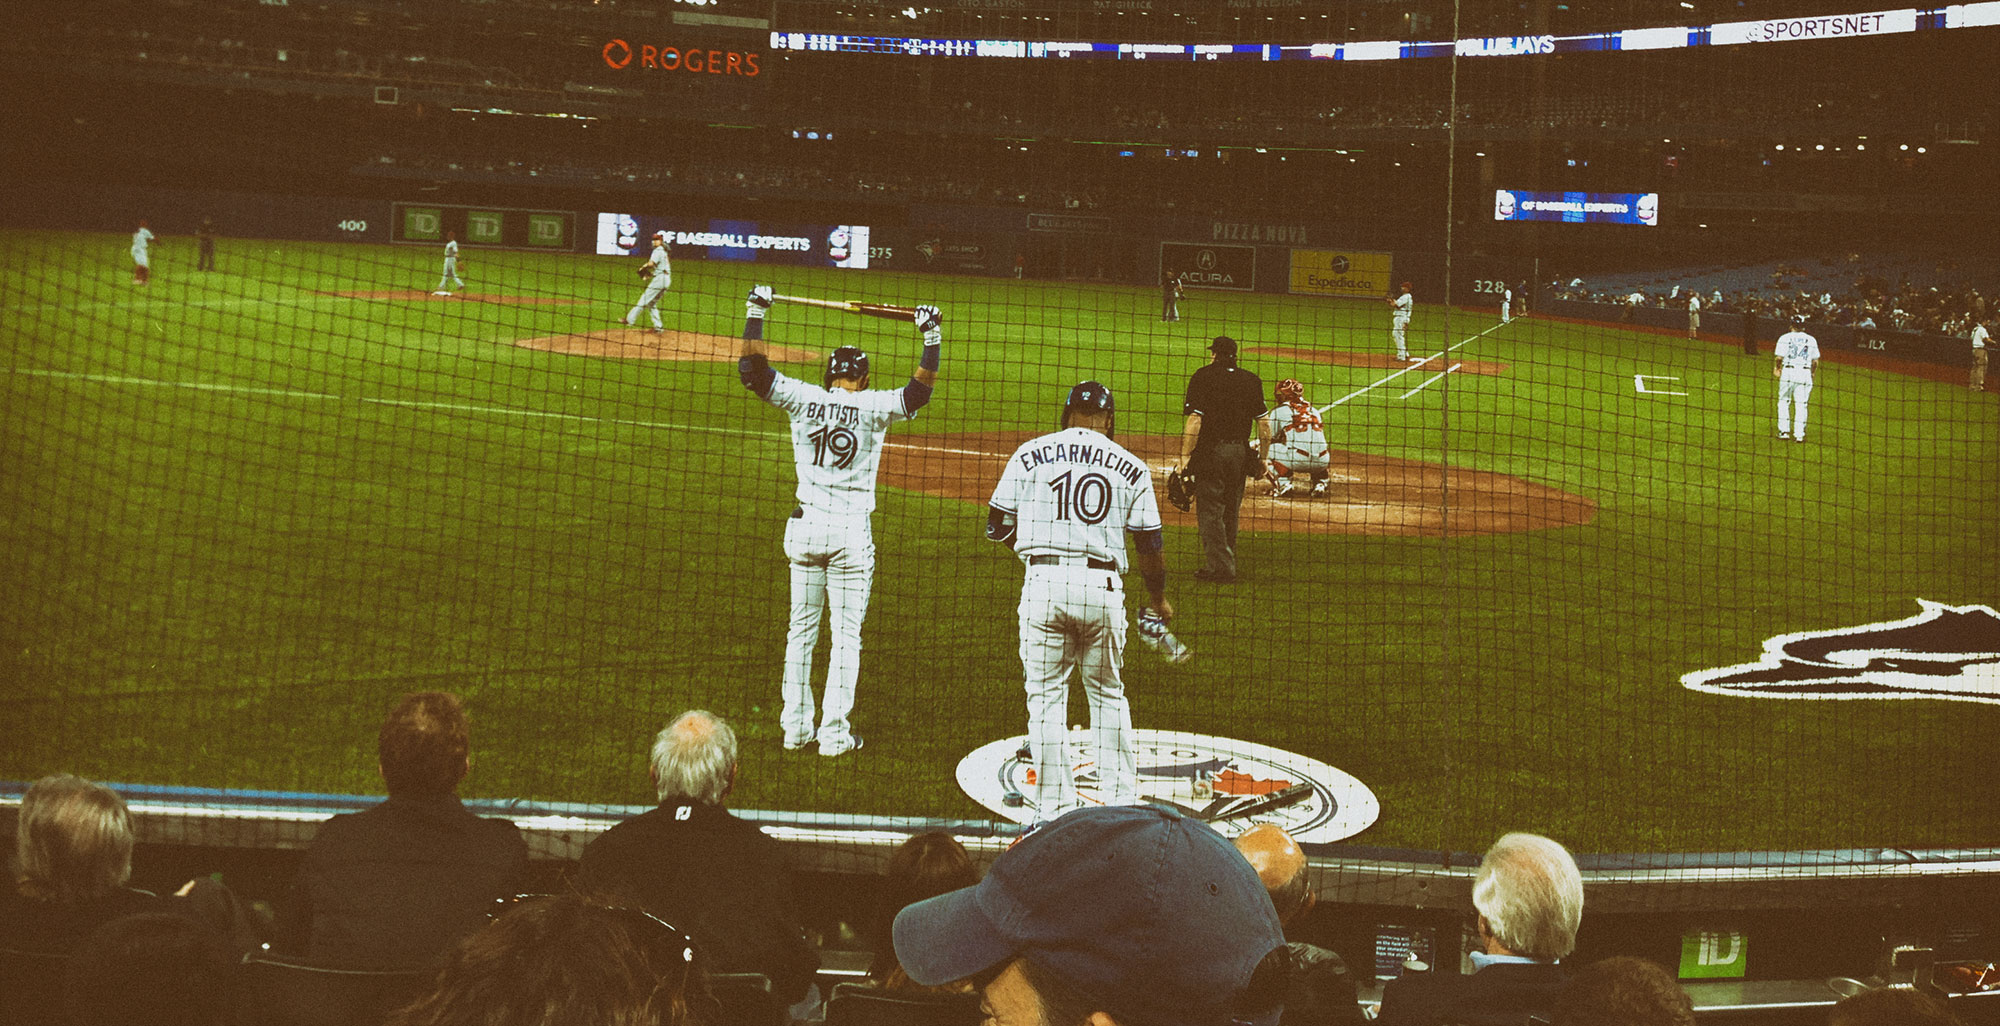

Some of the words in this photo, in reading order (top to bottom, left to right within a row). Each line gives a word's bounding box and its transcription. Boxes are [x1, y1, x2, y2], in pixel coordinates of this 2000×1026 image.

[1763, 14, 1884, 41] SPORTSNET
[641, 44, 760, 77] ROGERS
[338, 220, 367, 232] 400
[408, 213, 437, 234] TD
[471, 217, 500, 237] TD
[531, 220, 560, 240] TD
[1213, 222, 1259, 240] PIZZA
[1266, 225, 1307, 244] NOVA
[676, 232, 747, 248] BASEBALL
[748, 235, 811, 251] EXPERTS
[869, 247, 893, 259] 375
[1179, 271, 1234, 284] ACURA
[1308, 274, 1372, 290] Expedia.ca
[1473, 279, 1505, 294] 328
[807, 424, 858, 470] 19
[1020, 443, 1144, 486] ENCARNACION
[1050, 469, 1113, 525] 10
